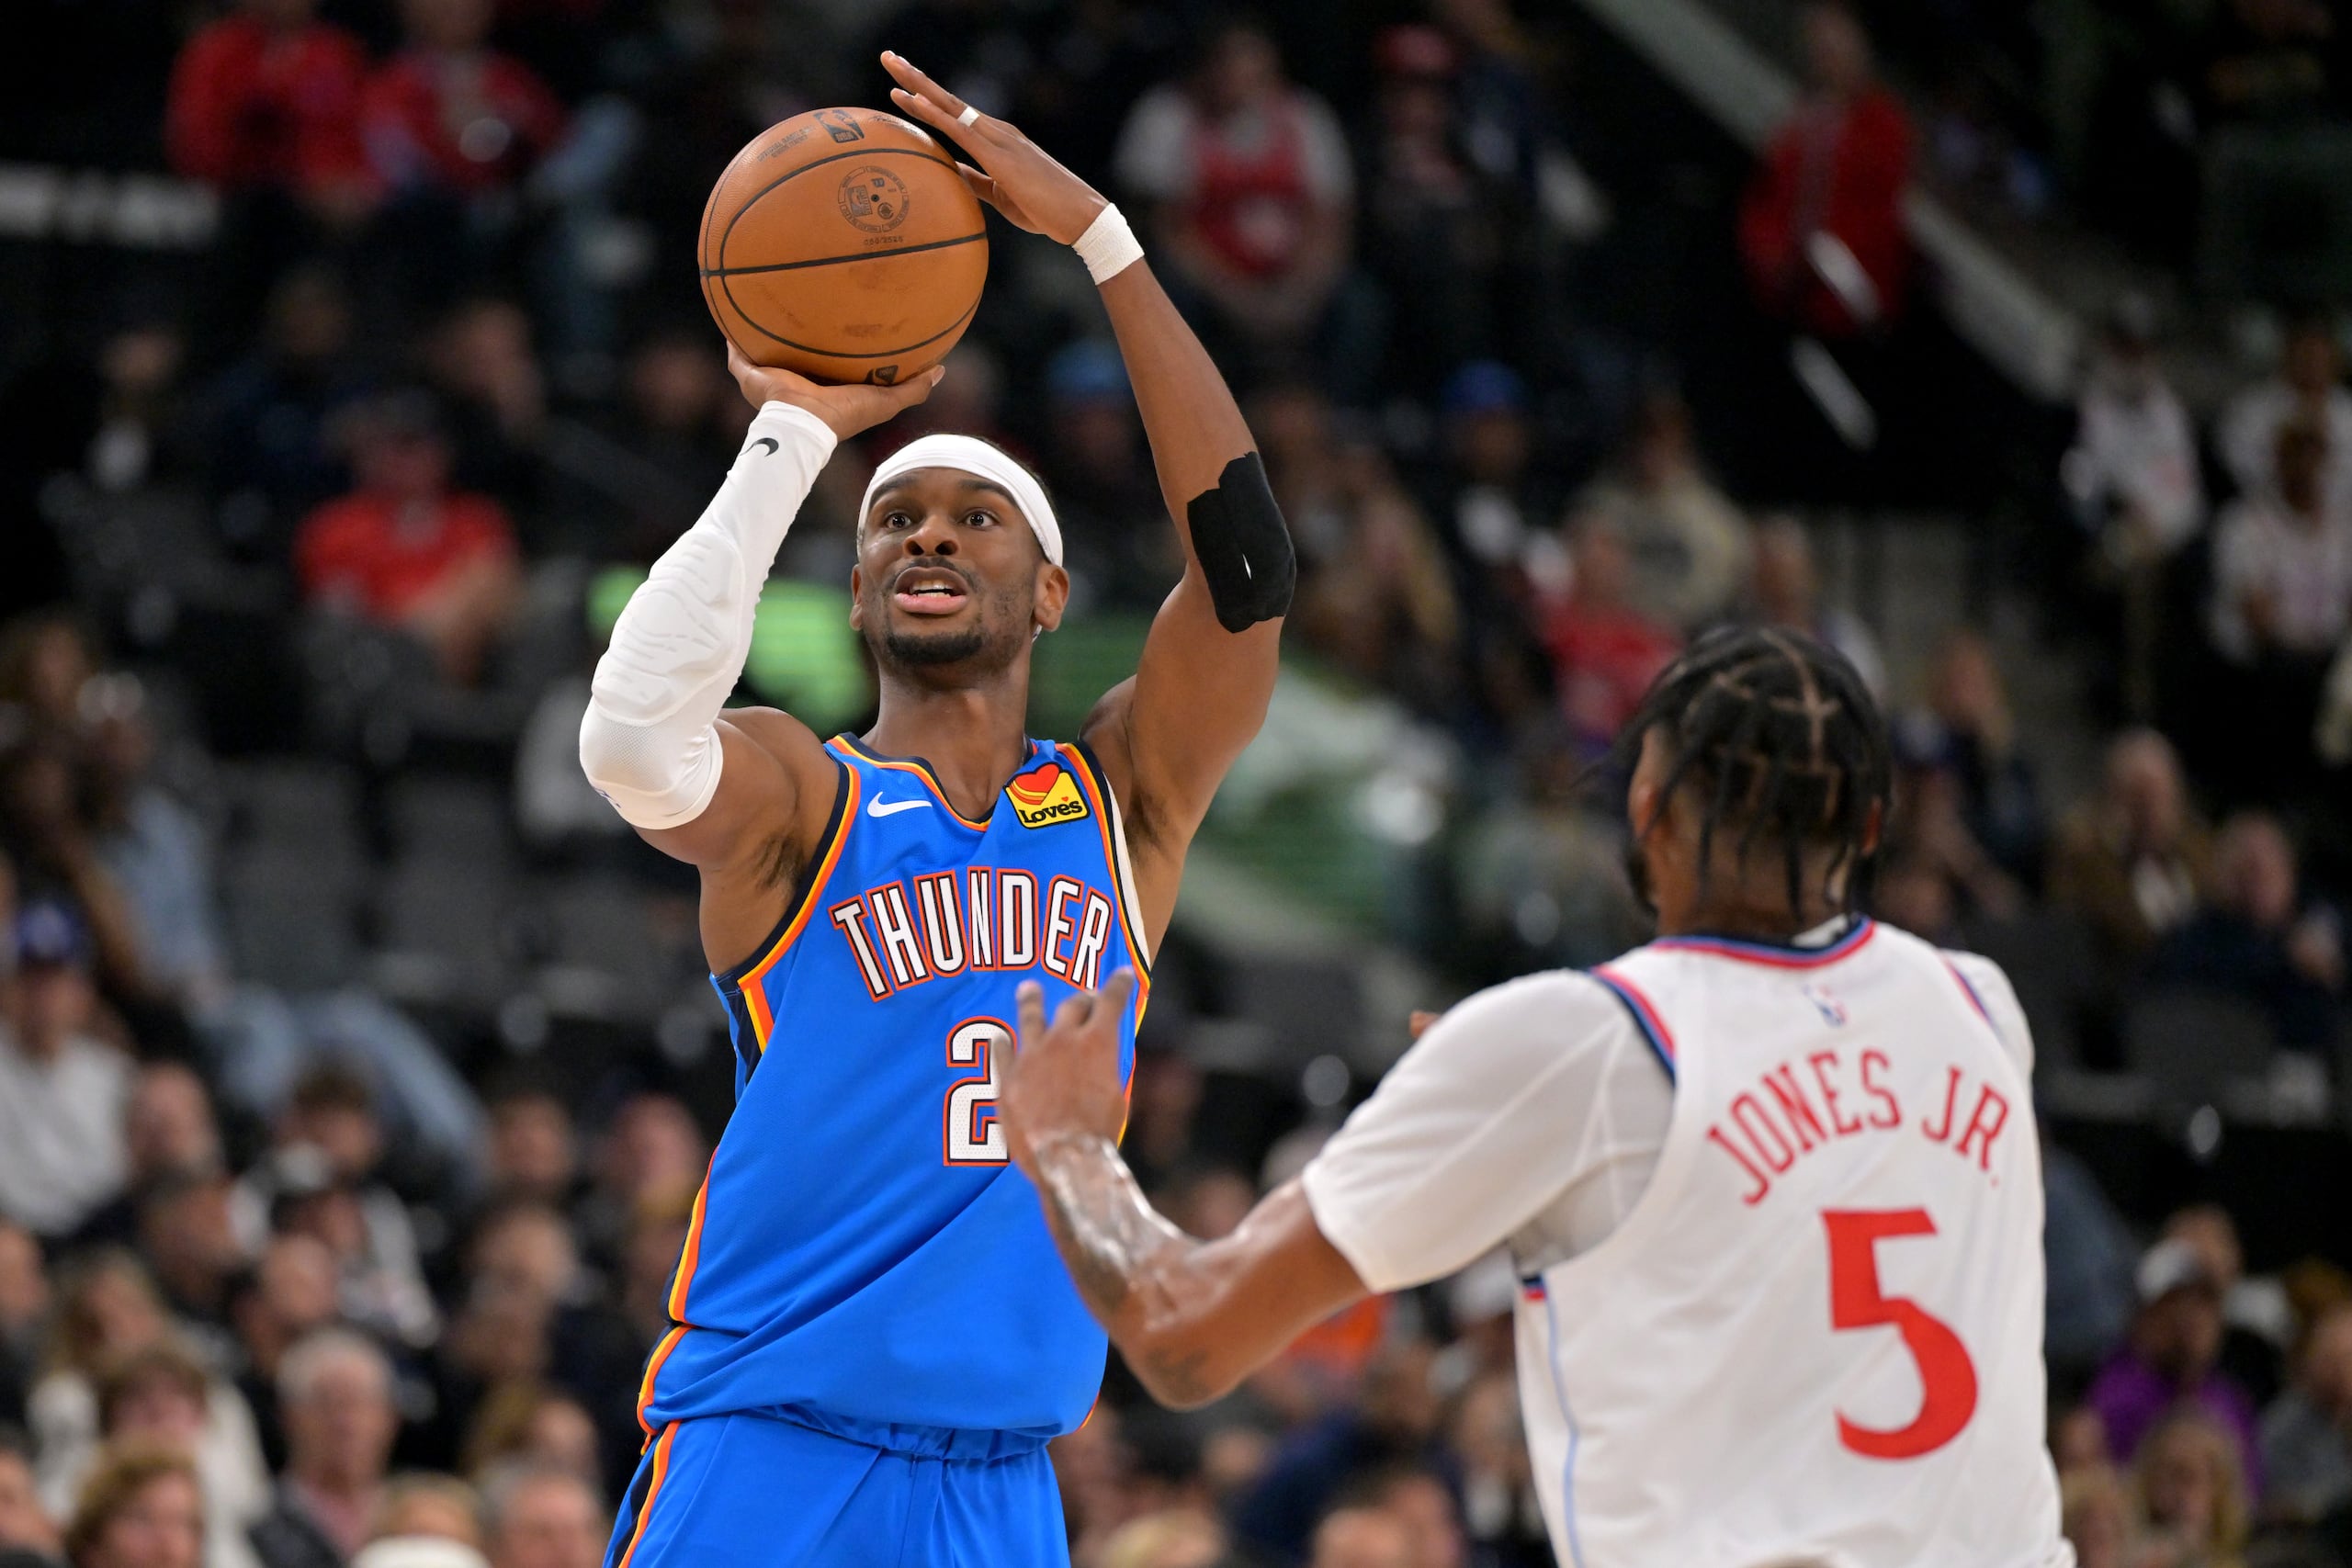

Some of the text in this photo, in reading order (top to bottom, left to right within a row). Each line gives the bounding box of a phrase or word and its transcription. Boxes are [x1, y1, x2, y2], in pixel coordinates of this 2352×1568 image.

[829, 866, 1112, 1002] THUNDER
[943, 1016, 1016, 1167] 2
[1706, 1048, 1902, 1207] JONES
[1819, 1207, 1978, 1461] 5
